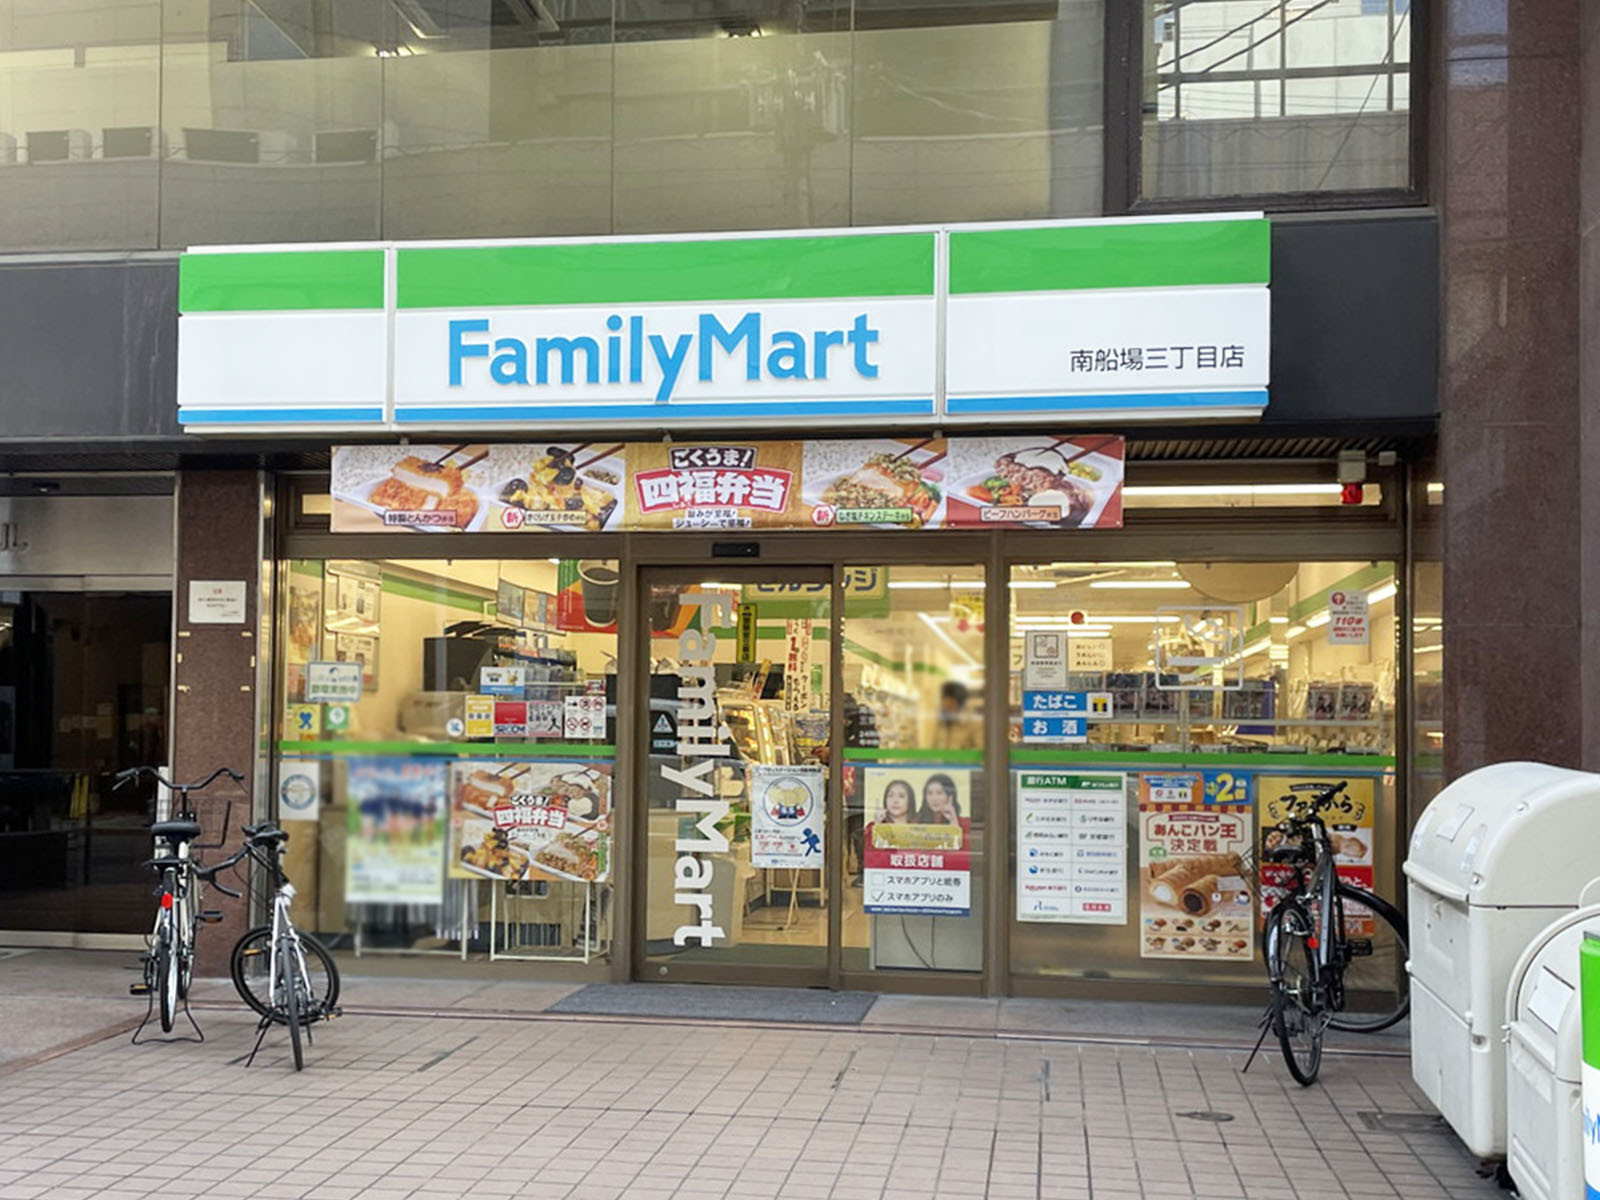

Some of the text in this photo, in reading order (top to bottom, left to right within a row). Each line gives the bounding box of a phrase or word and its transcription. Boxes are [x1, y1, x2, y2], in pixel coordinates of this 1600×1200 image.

[449, 312, 879, 405] FamilyMart
[1070, 345, 1245, 372] 南船場三丁目店
[640, 470, 786, 508] 四福弁当
[1032, 694, 1077, 709] たばこ
[660, 593, 732, 947] FamilyMart
[890, 854, 944, 868] 取扱店舗
[887, 891, 954, 903] スマホアプリのみ
